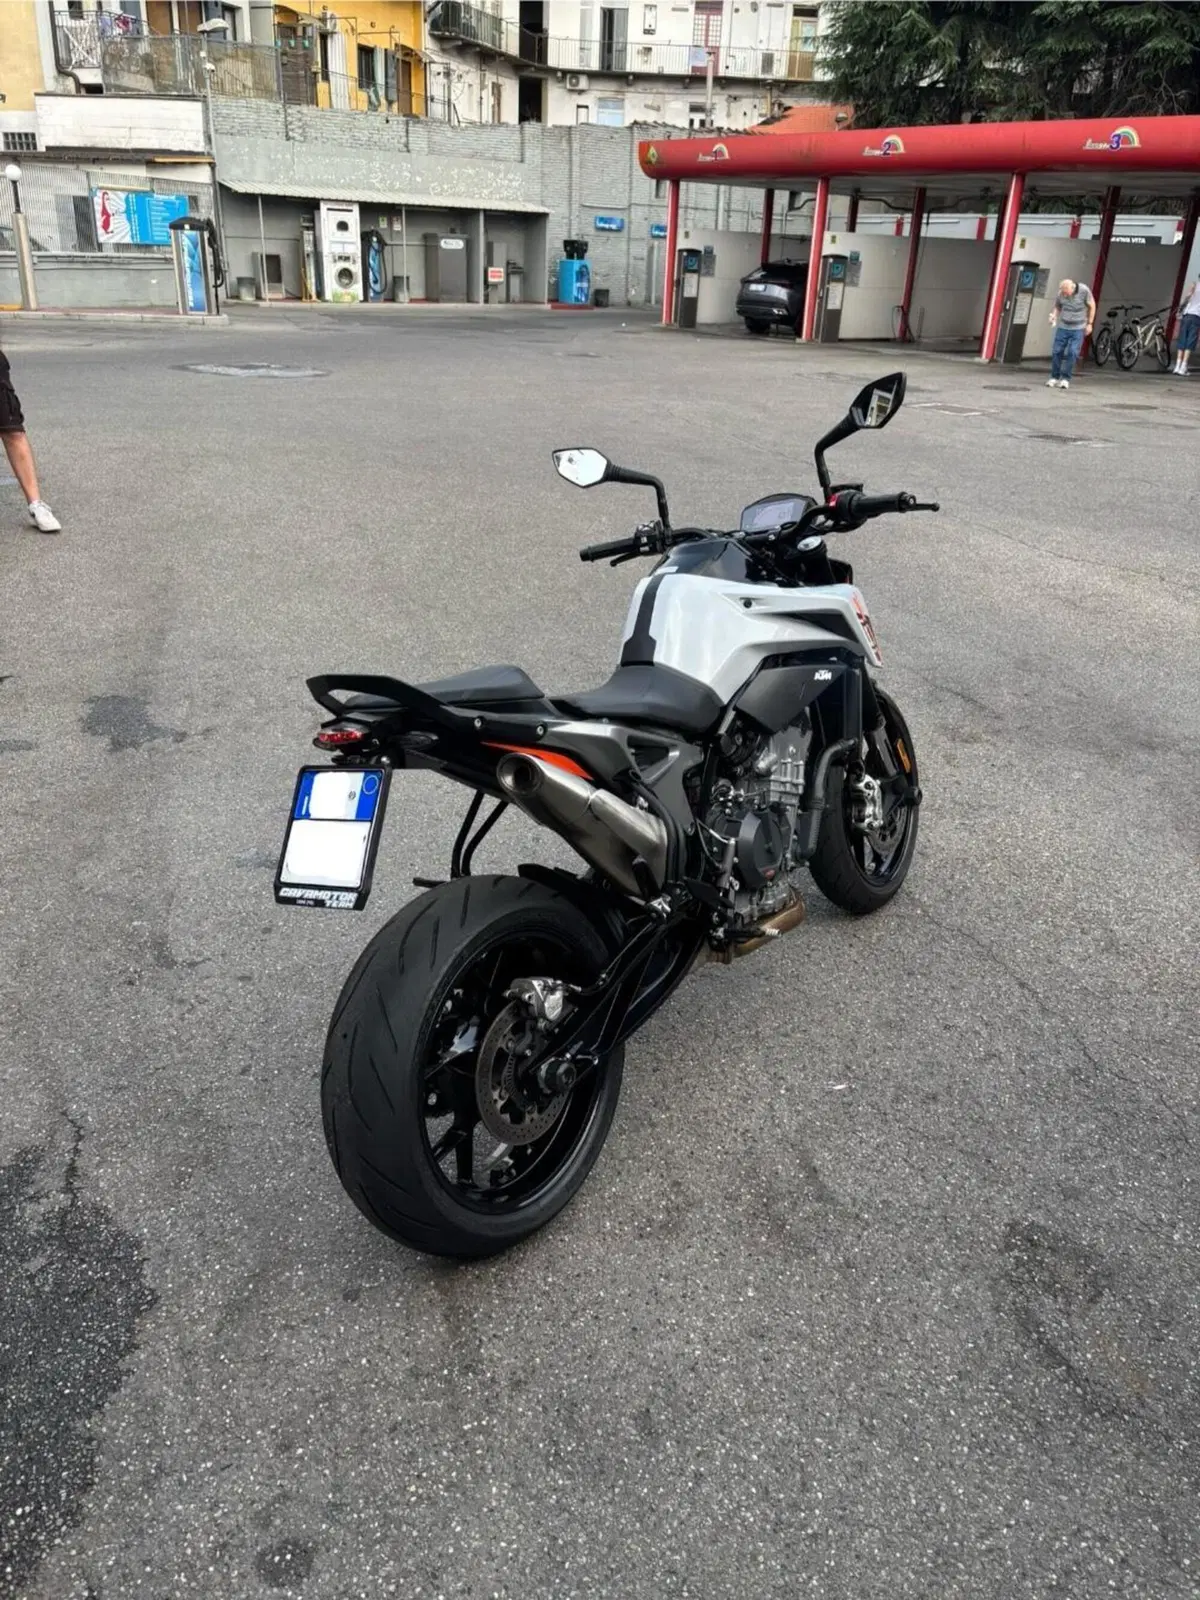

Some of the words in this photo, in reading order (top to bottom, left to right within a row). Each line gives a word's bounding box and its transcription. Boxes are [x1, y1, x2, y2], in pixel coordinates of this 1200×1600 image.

[1109, 134, 1121, 150] 3
[814, 669, 832, 680] KTM
[325, 900, 354, 909] TEAM
